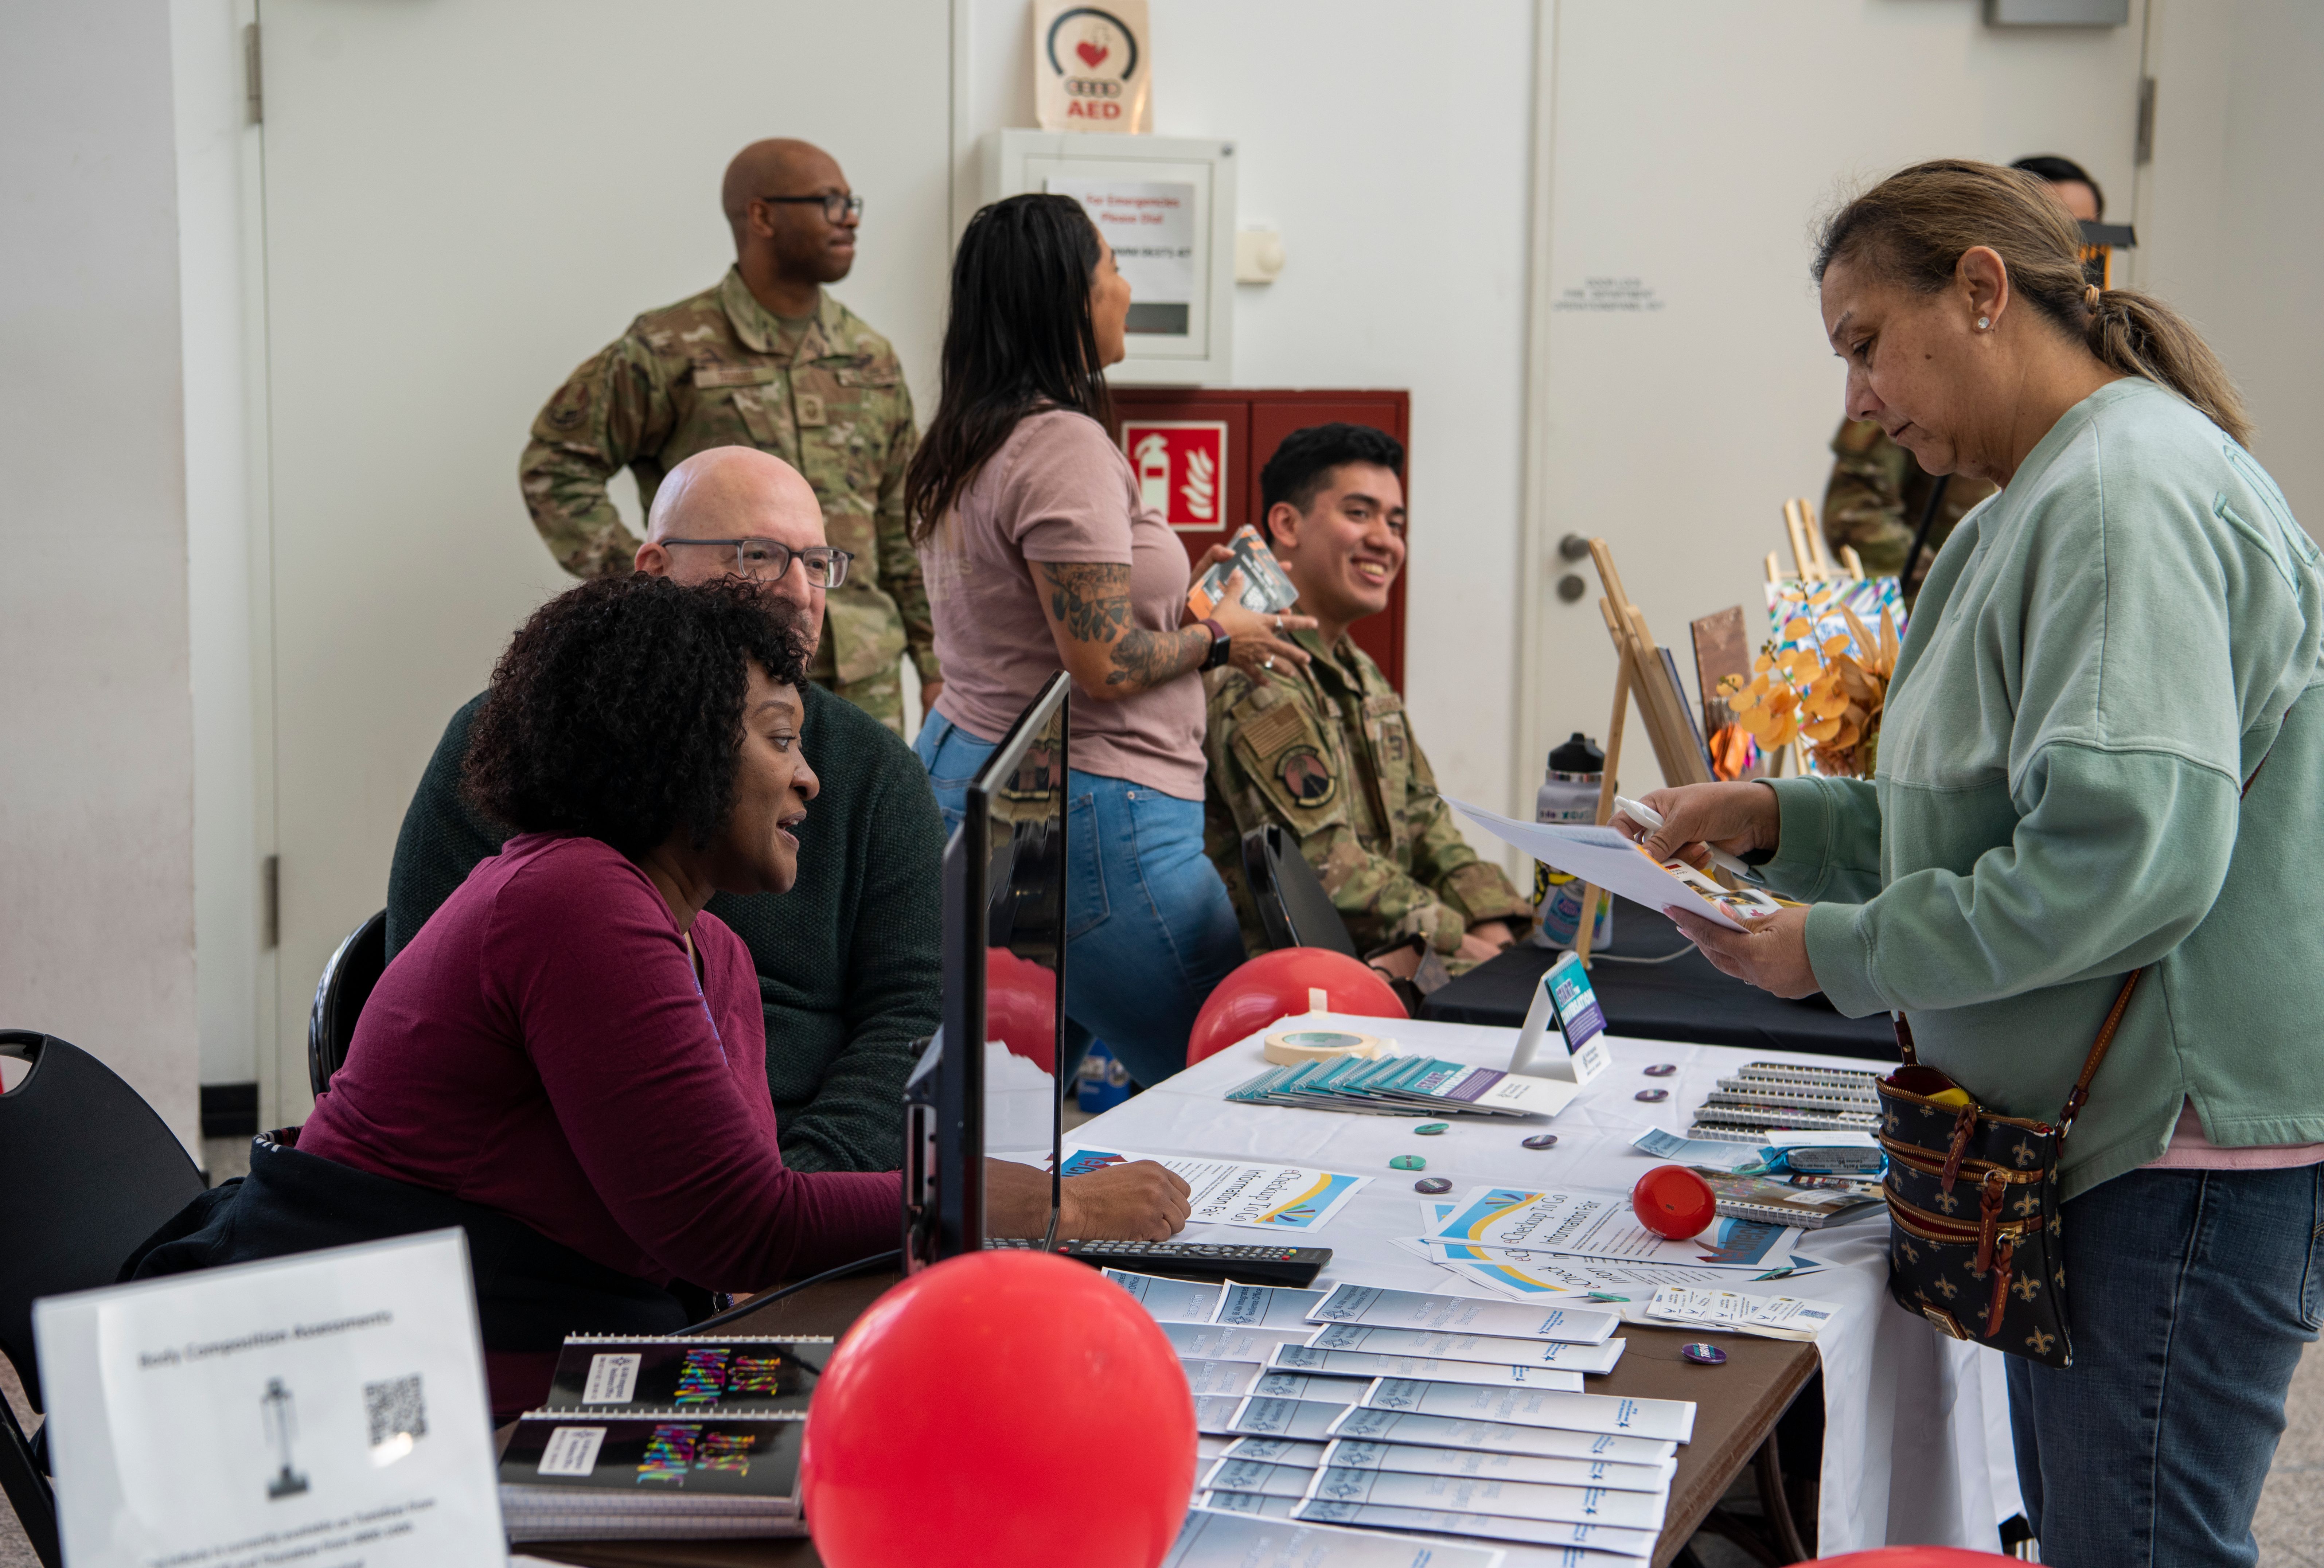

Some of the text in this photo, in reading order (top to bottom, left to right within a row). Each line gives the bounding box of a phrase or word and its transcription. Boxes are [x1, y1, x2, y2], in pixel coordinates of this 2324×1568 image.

[1067, 100, 1121, 120] AED
[1108, 194, 1180, 208] Emergencies
[1101, 212, 1163, 225] Please Dial
[1212, 1169, 1267, 1206] Information
[1231, 1169, 1302, 1221] eCheckup To Go
[1198, 1205, 1227, 1216] Fair
[1501, 1213, 1555, 1244] eCheckup
[1541, 1195, 1568, 1203] Go
[1539, 1210, 1591, 1245] Information
[1575, 1201, 1602, 1211] Fair
[1128, 1276, 1140, 1290] Office
[1342, 1286, 1360, 1301] Integrated
[1183, 1295, 1205, 1318] Ramstein
[1236, 1287, 1249, 1305] Integrated
[1246, 1288, 1263, 1316] Resilience Office
[1348, 1288, 1373, 1310] Resilience Office
[184, 1330, 289, 1361] Composition
[293, 1310, 394, 1338] Assessments
